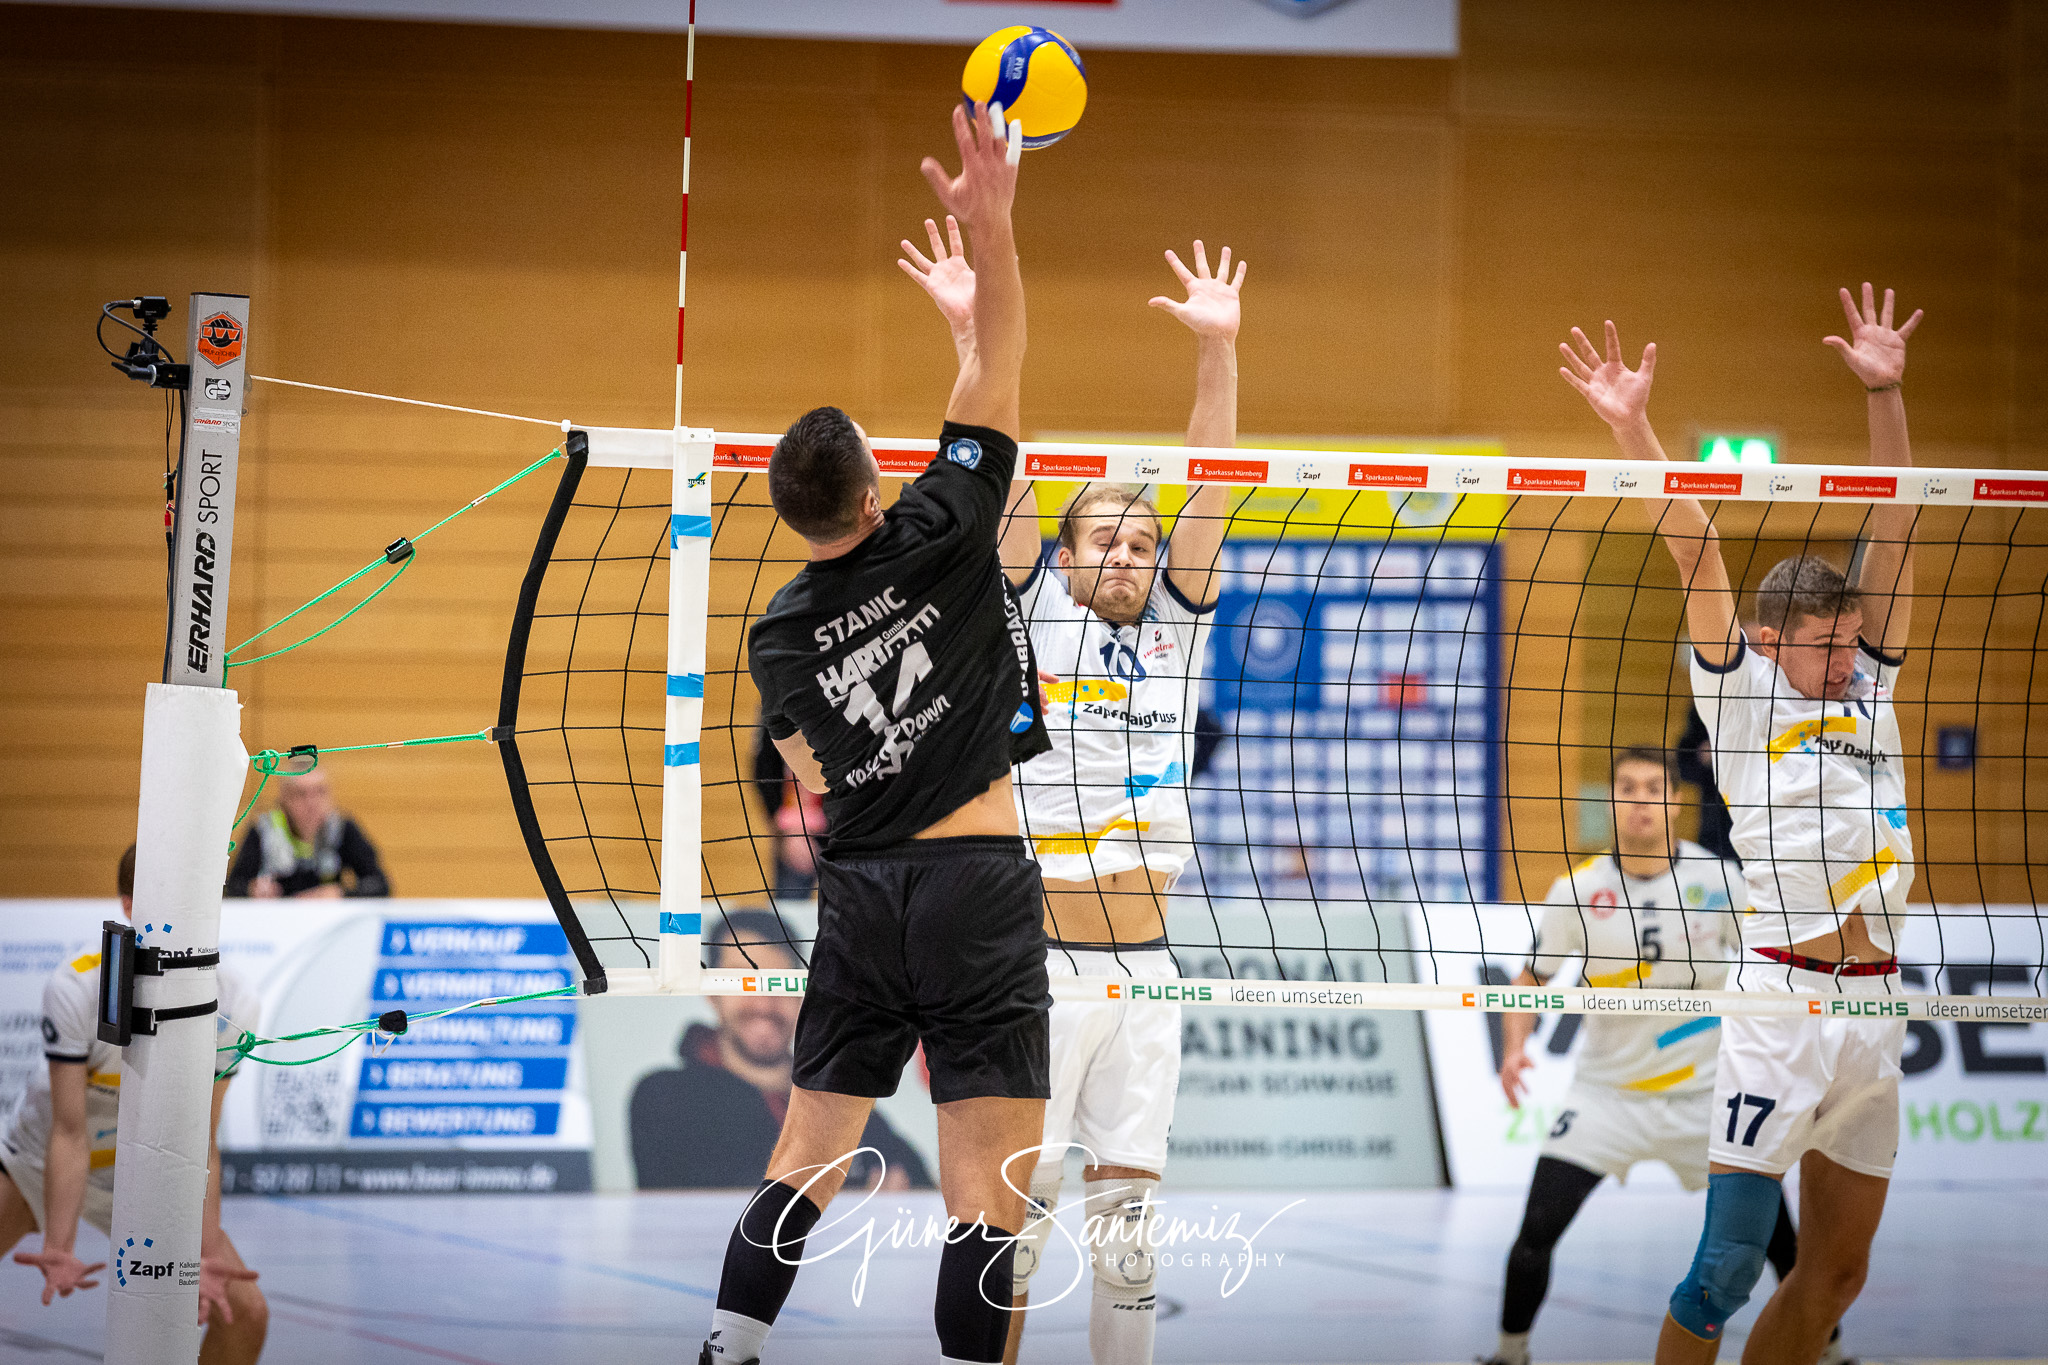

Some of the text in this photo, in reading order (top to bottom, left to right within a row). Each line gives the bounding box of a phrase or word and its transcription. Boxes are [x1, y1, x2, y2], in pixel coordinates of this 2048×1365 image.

[878, 459, 908, 467] Sparkasse
[1042, 464, 1101, 473] Sparkasse Nürnberg
[1141, 467, 1160, 475] Zapf
[1204, 469, 1263, 478] Sparkasse Nürnberg
[1302, 472, 1321, 480] Zapf
[1365, 474, 1422, 483] Sparkasse Nürnberg
[1462, 477, 1480, 485] Zapf
[1523, 478, 1580, 487] Sparkasse Nürnberg
[198, 449, 222, 524] SPORT
[1680, 482, 1737, 490] Sparkasse Nürnberg
[1775, 484, 1793, 492] Zapf
[1865, 485, 1891, 493] Nürnberg
[1989, 488, 2045, 497] Sparkasse Nürnberg
[814, 586, 907, 652] STANIC
[881, 618, 908, 640] GmbH
[842, 641, 934, 735] 14
[1642, 926, 1661, 961] 5
[1131, 984, 1363, 1005] FUCHS Ideen umsetzen
[1486, 993, 1712, 1012] FUCHS Ideen umsetzen
[1832, 1000, 1909, 1016] FUCHS
[1926, 1000, 1970, 1017] Ideen
[1726, 1091, 1777, 1147] 17
[1549, 1110, 1577, 1138] 5
[129, 1260, 175, 1280] Zapf
